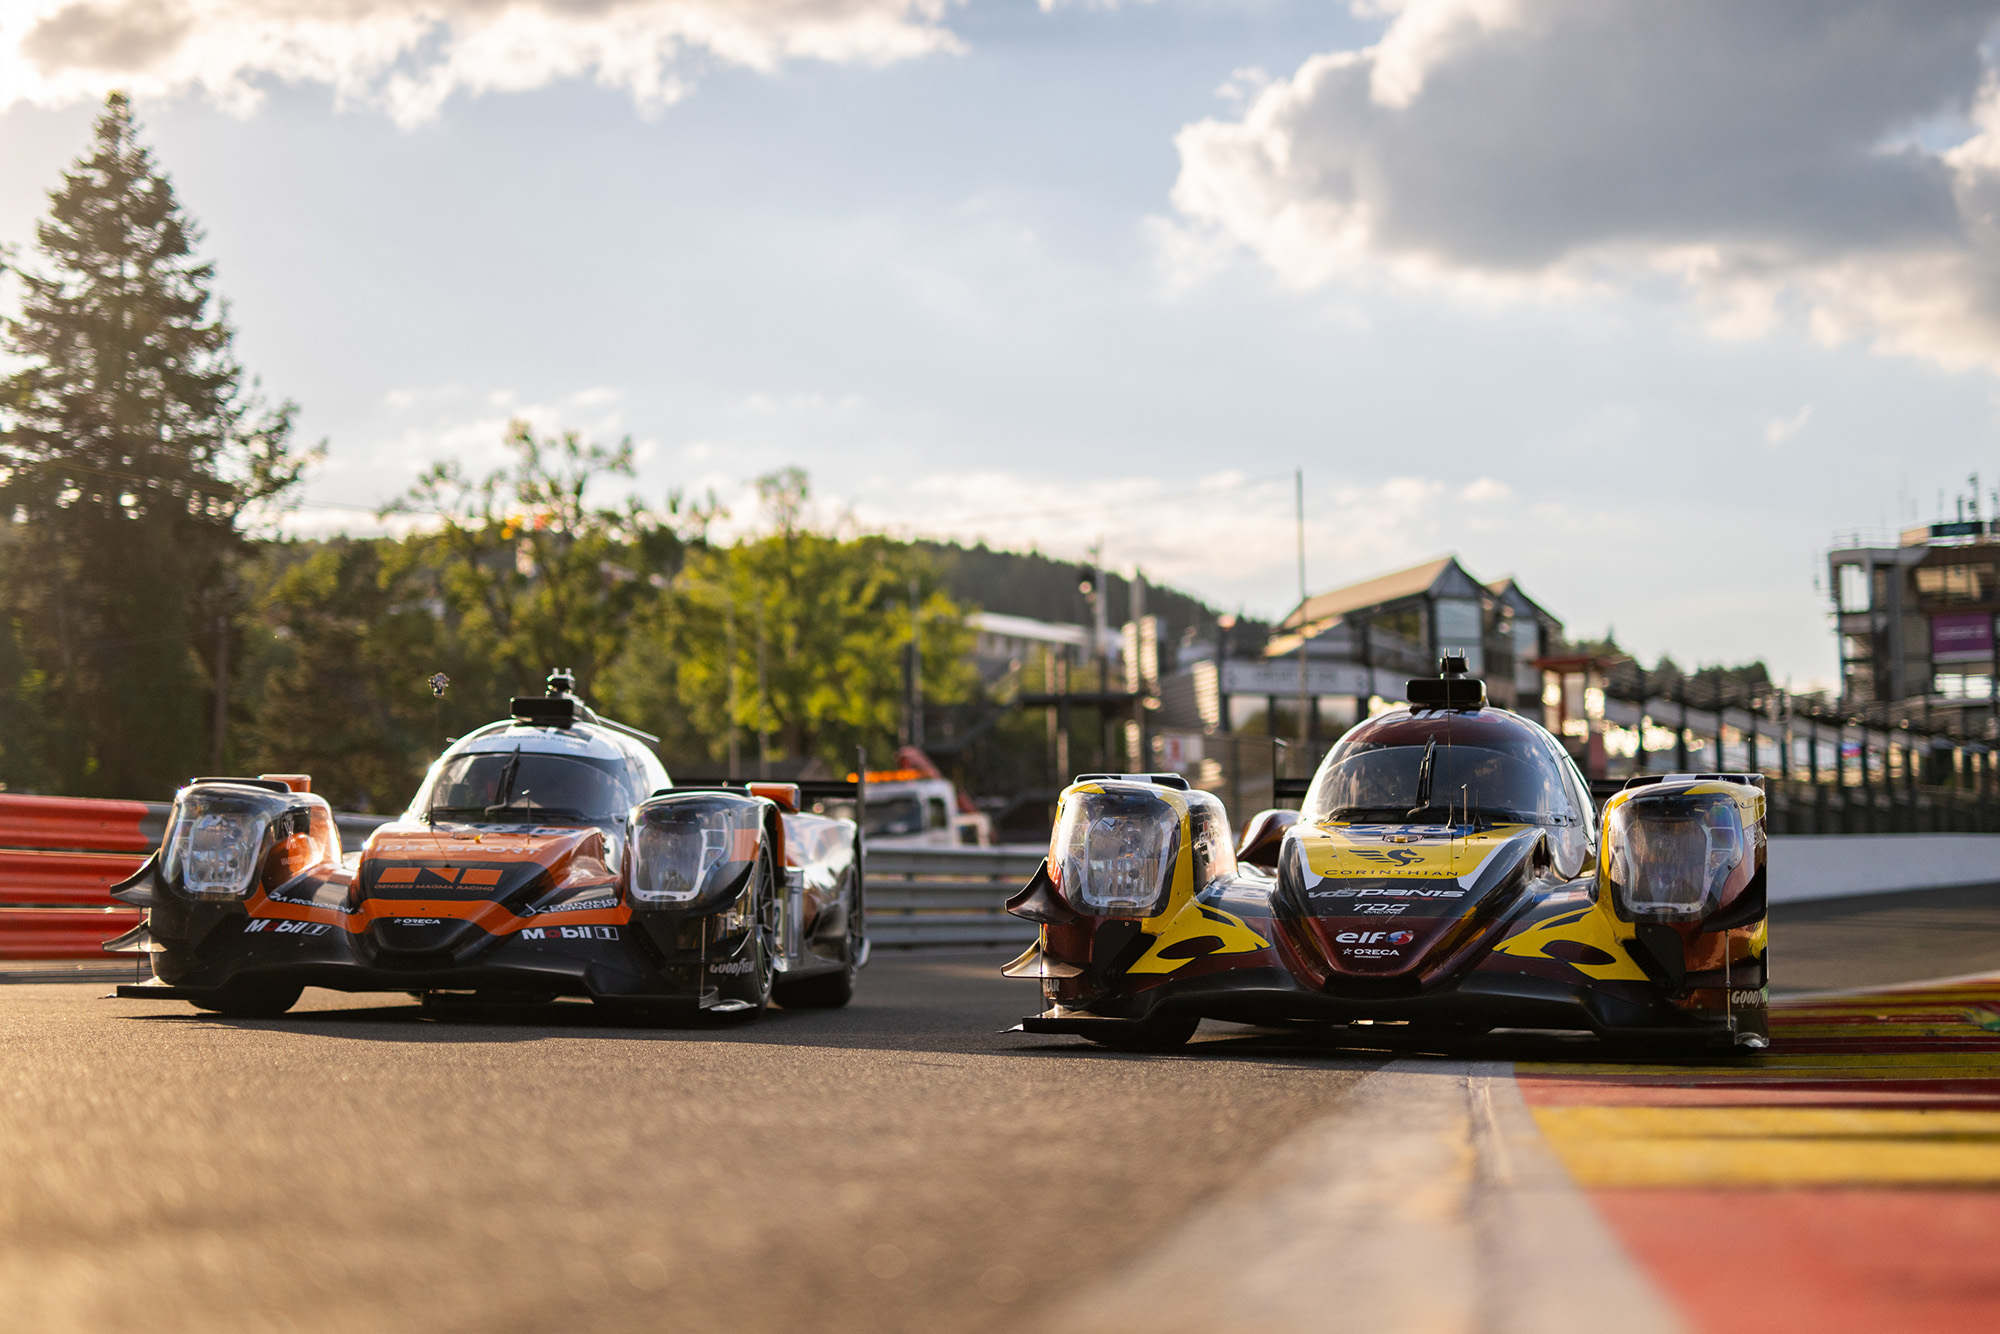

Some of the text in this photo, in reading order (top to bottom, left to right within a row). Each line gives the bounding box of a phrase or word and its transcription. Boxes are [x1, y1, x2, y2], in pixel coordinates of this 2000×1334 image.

[447, 844, 544, 855] SPORT
[1324, 869, 1459, 878] CORINTHIAN
[415, 883, 454, 891] MAGMA
[288, 897, 355, 914] PROMOTION
[1353, 903, 1411, 913] TDS
[243, 919, 308, 934] Mobil
[521, 926, 592, 940] Mobil
[1335, 931, 1387, 944] elf
[1354, 948, 1400, 956] ORECA
